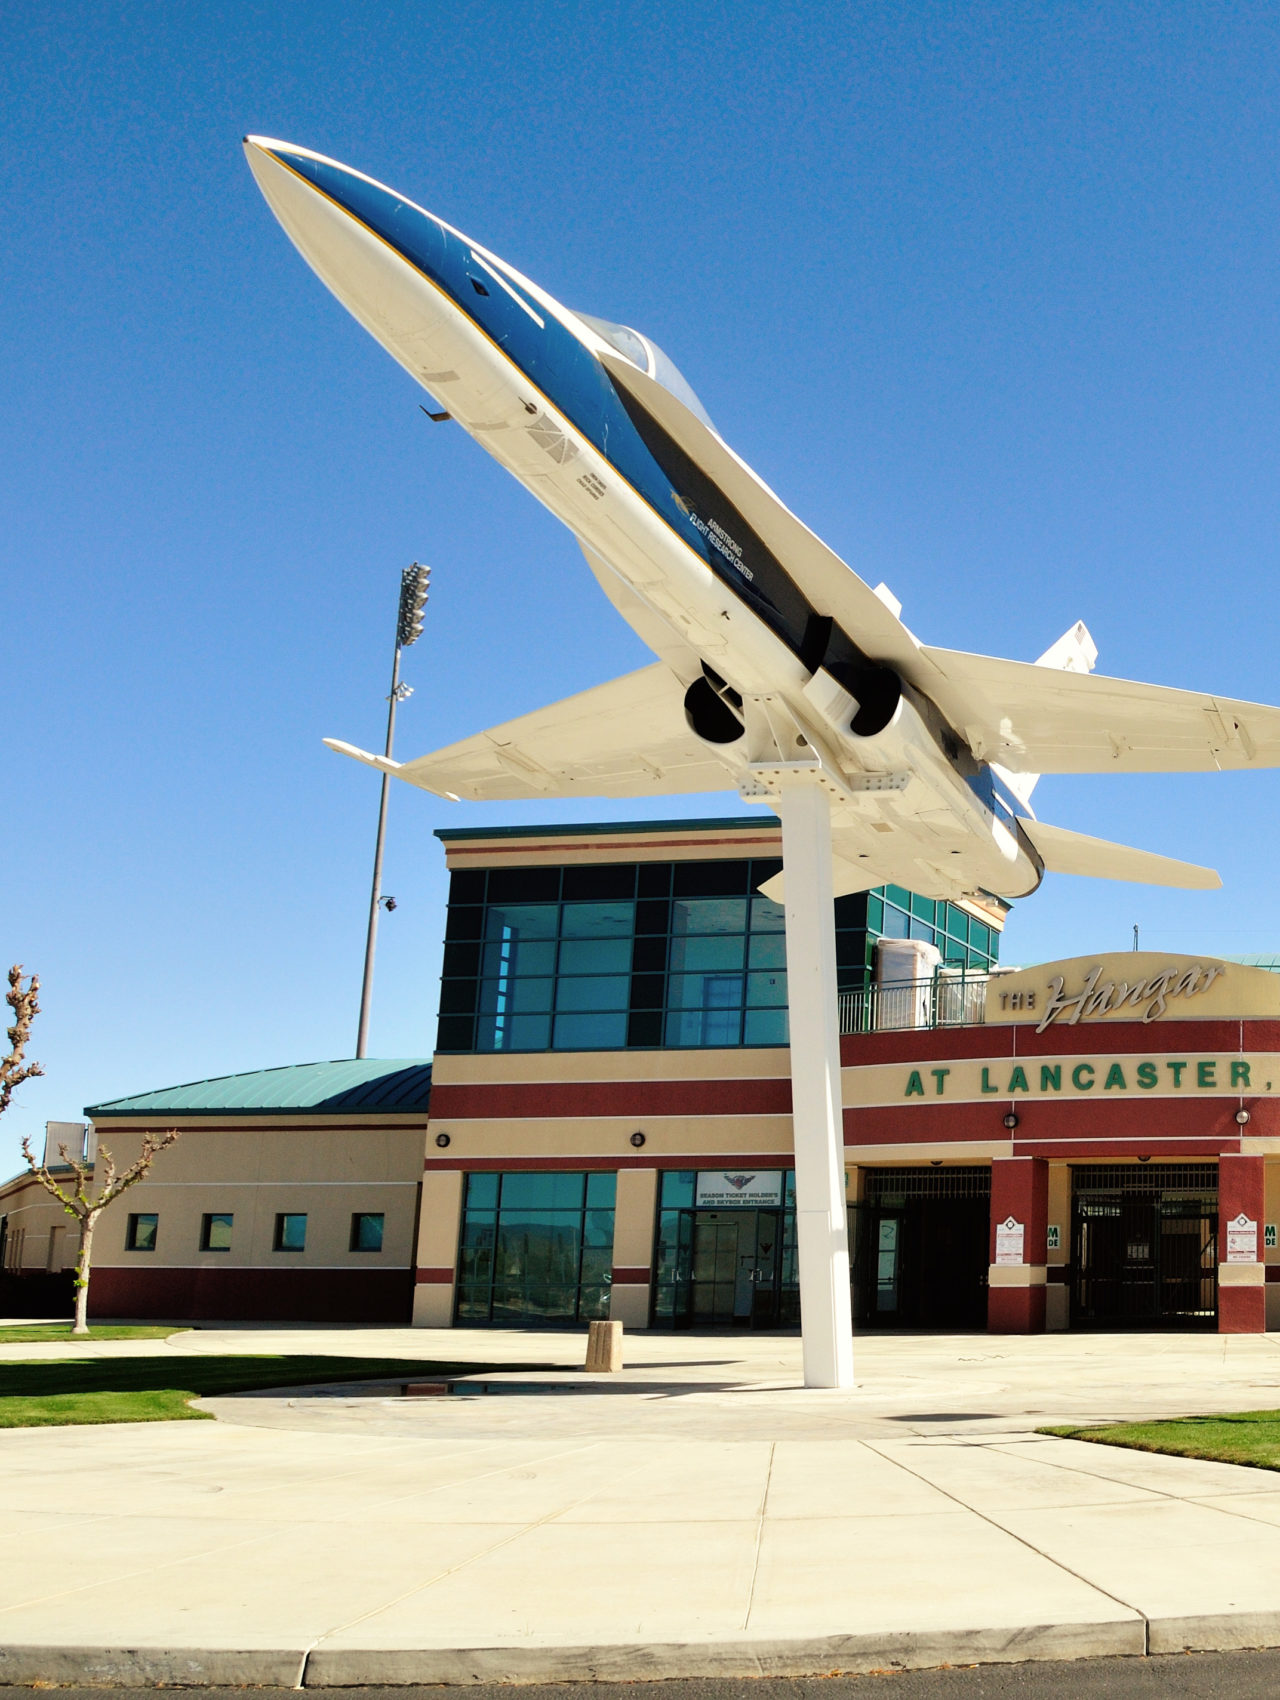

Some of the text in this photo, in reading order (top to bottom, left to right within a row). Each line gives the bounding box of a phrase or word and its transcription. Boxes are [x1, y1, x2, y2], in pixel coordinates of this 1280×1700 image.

[689, 512, 754, 582] FLIGHT RESEARCH CENTER
[707, 518, 743, 557] ARMSTRONG
[1000, 964, 1226, 1033] THE Hangar
[905, 1069, 950, 1096] AT
[981, 1061, 1273, 1093] LANCASTER,
